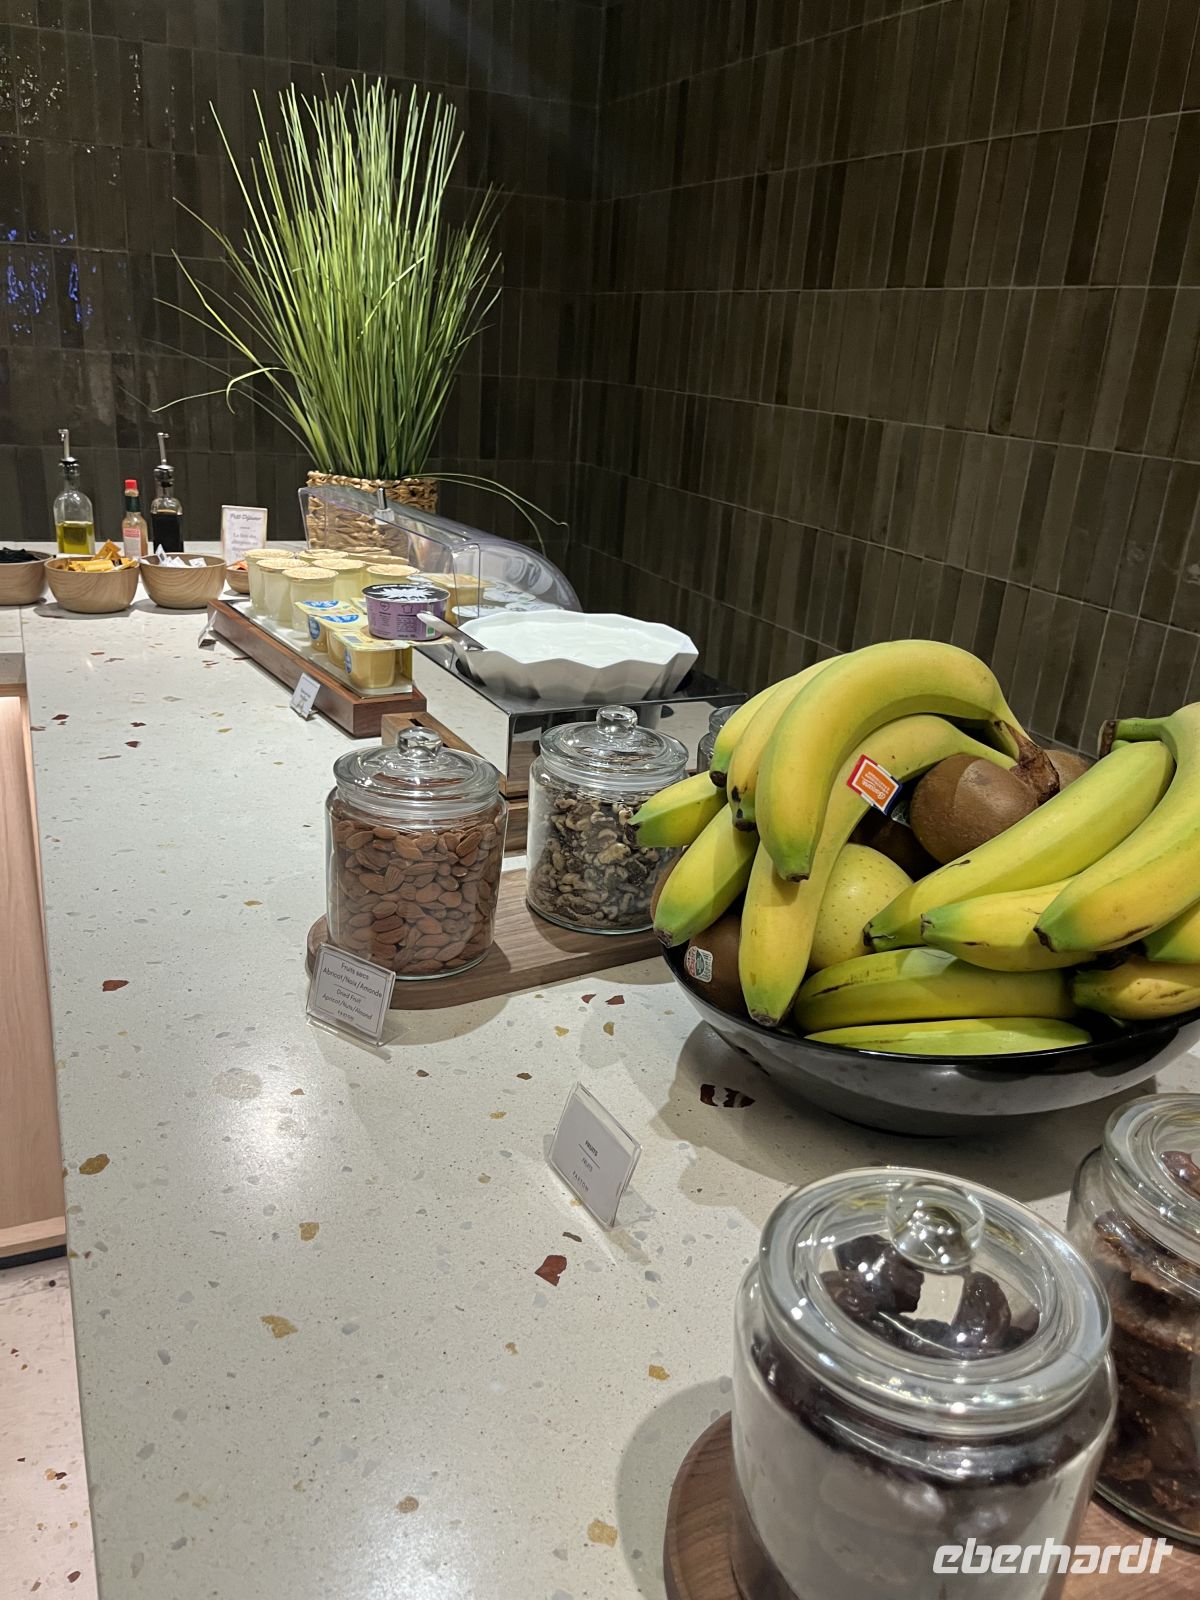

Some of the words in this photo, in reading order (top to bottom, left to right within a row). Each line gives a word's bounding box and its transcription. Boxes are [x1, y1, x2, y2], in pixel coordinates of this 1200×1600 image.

[341, 963, 355, 975] Fruits
[336, 988, 350, 999] Dried
[350, 995, 362, 1004] Fruit
[585, 1140, 598, 1157] FRUITS
